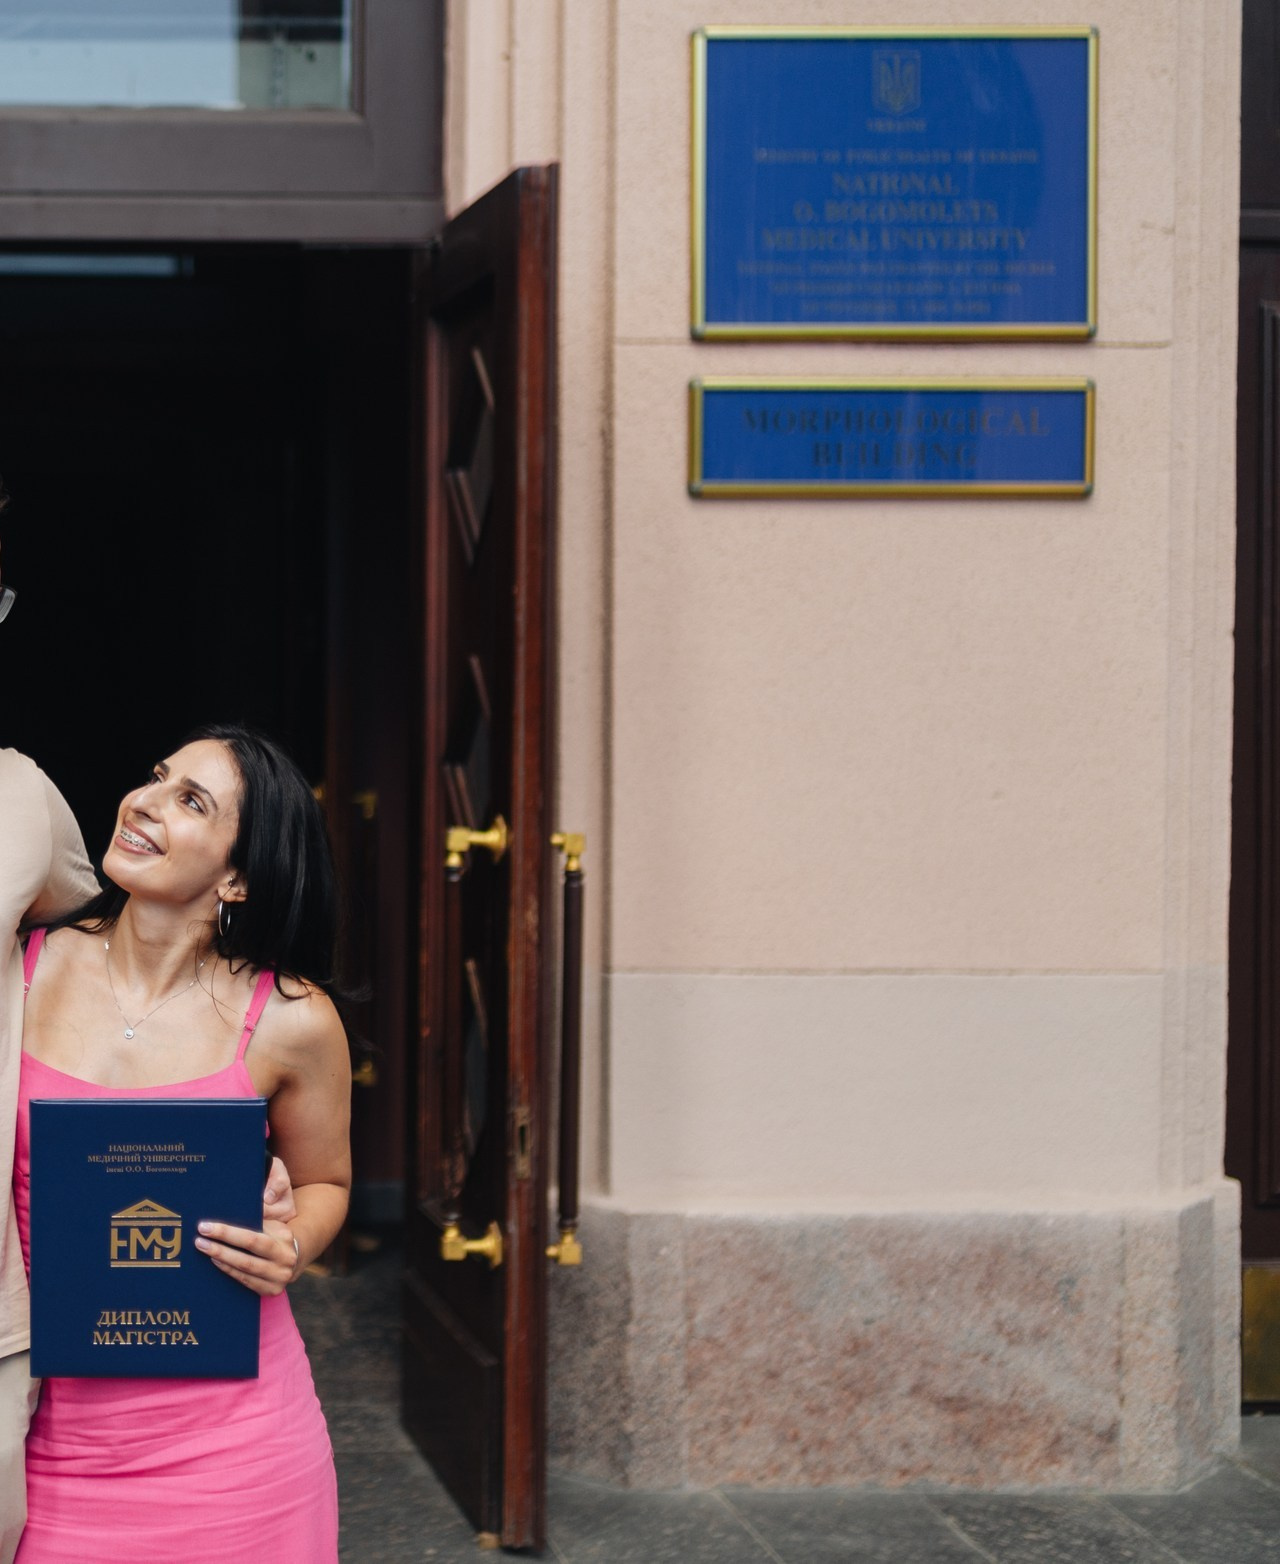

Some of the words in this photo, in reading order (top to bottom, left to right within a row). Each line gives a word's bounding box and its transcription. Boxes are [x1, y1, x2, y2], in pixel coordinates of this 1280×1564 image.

[832, 171, 959, 196] NATIONAL
[762, 227, 877, 252] MEDICAL
[882, 227, 1029, 252] UNIVERSITY
[744, 407, 1051, 437] MORPHOLOGICAL
[813, 441, 978, 468] BUILDING
[87, 1153, 141, 1163] МЕДИЧНИЙ
[143, 1155, 207, 1163] УНІВЕРСИТЕТ
[109, 1143, 185, 1153] НАЦІОНАЛЬНИЙ
[97, 1311, 190, 1327] ДИПЛОМ
[93, 1331, 199, 1345] МАГІСТРА
